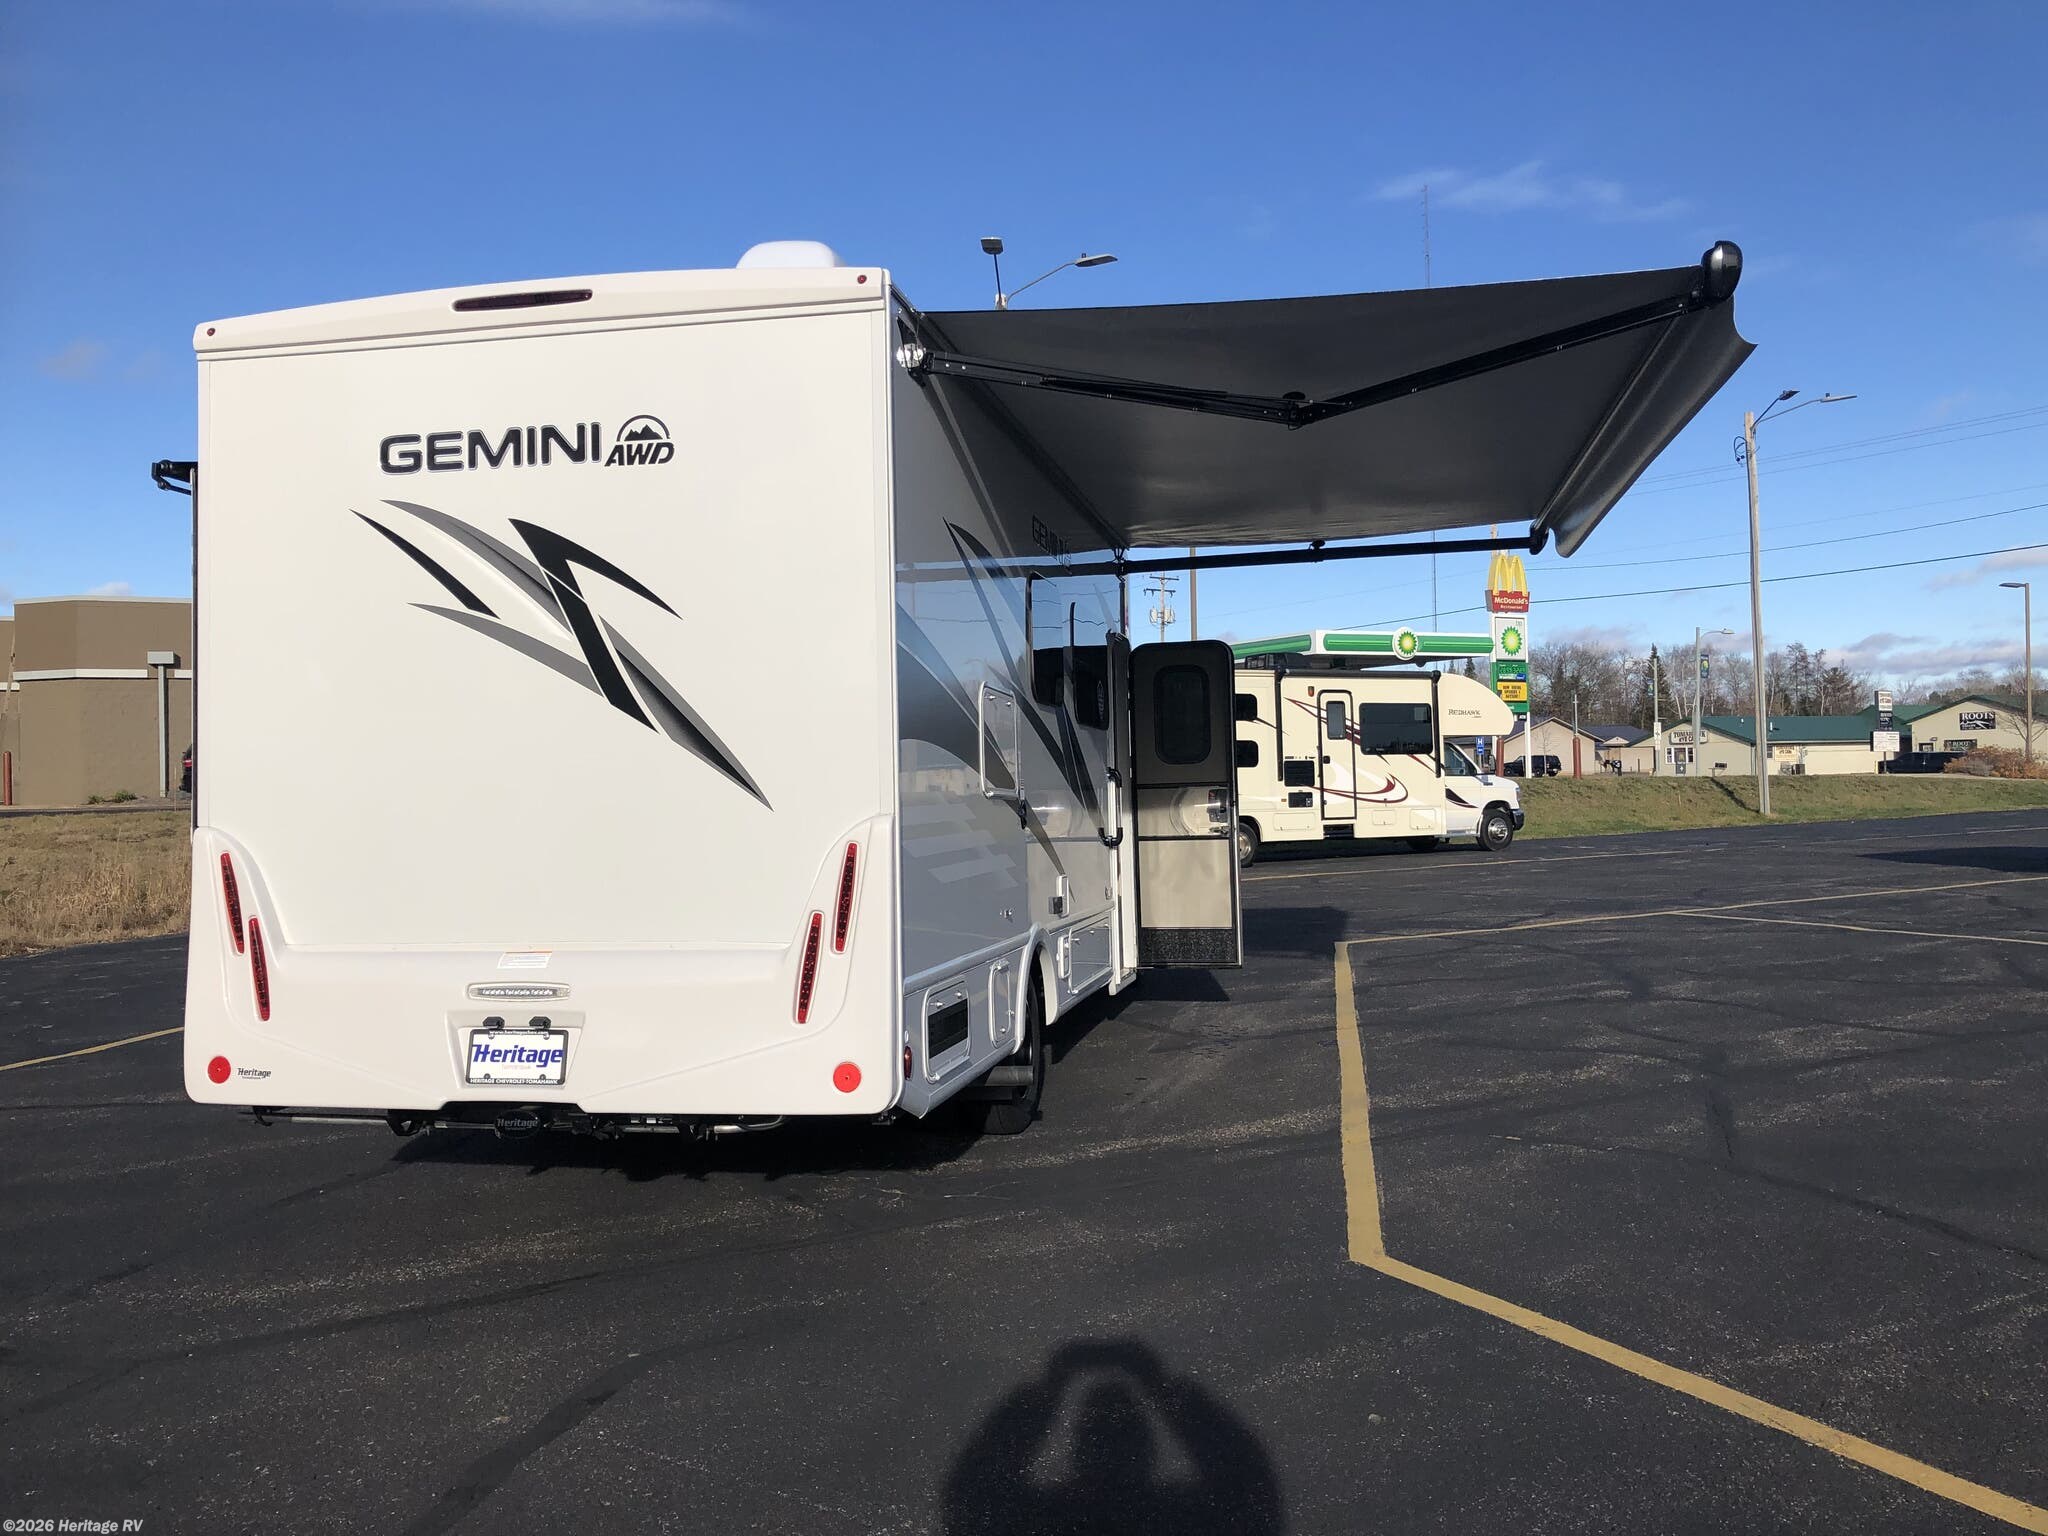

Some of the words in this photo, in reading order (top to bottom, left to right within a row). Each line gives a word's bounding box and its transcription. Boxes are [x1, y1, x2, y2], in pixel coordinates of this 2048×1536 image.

[379, 422, 602, 475] GEMINI
[604, 441, 675, 467] AWD
[1494, 596, 1529, 605] McDonald's
[1448, 708, 1481, 716] REDHAWK
[1961, 711, 1995, 720] ROOTS
[472, 1044, 564, 1068] Heritage
[237, 1067, 272, 1079] Heritage
[497, 1118, 538, 1128] Heritage
